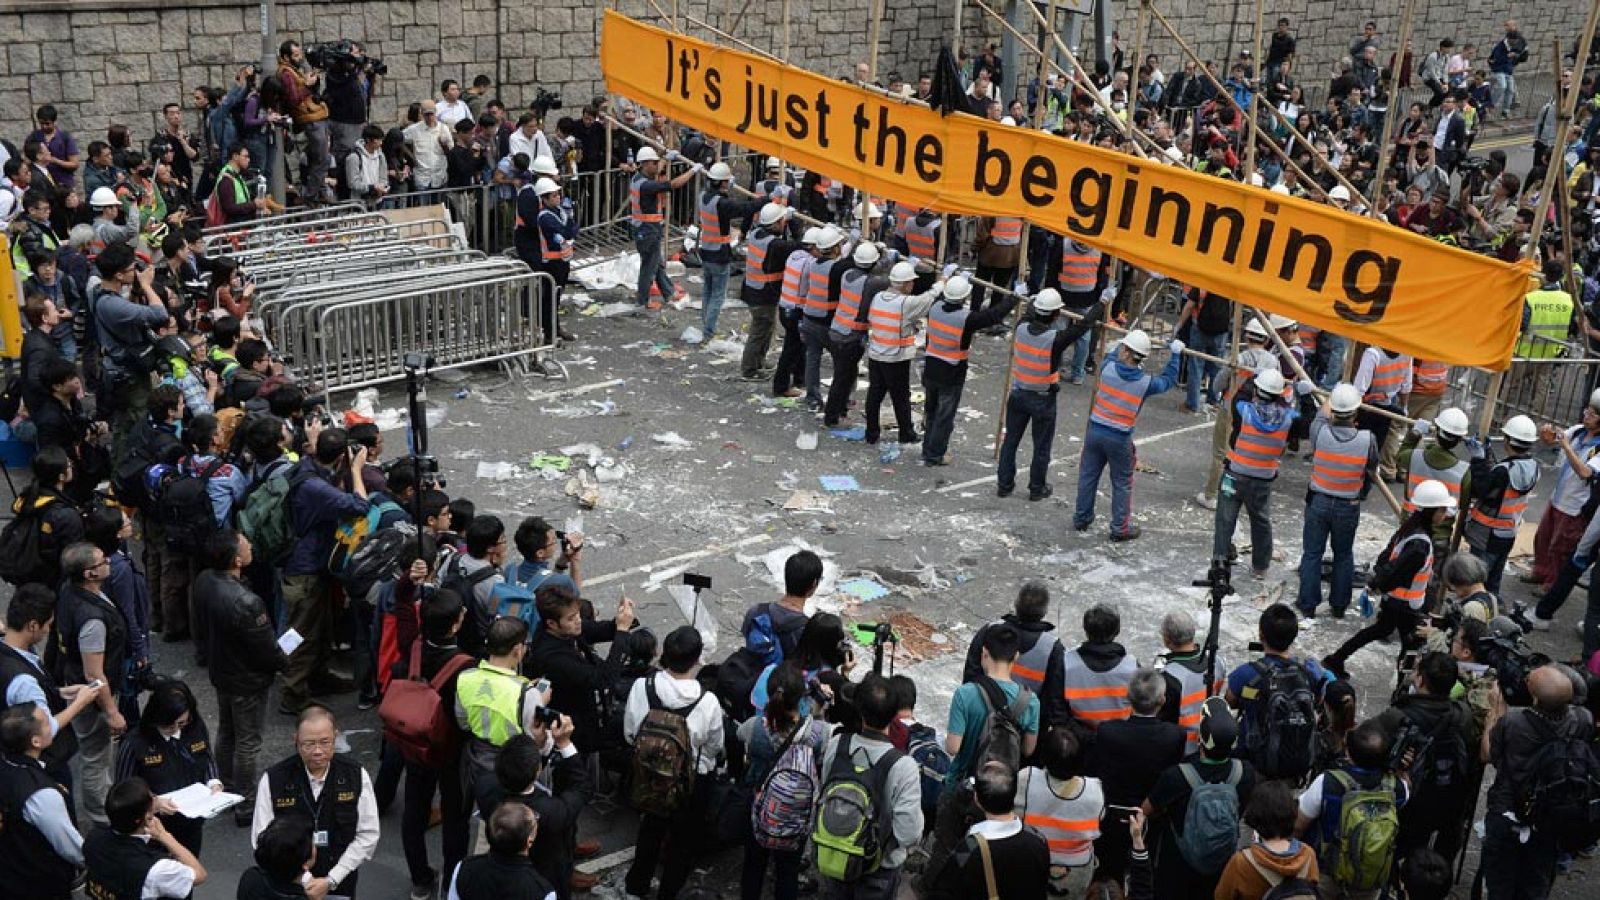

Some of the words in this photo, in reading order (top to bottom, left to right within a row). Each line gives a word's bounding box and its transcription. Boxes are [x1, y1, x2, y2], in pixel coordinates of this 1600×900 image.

[664, 38, 722, 111] It's
[735, 64, 831, 148] just
[852, 102, 944, 184] the
[973, 129, 1402, 324] beginning
[1533, 303, 1569, 313] PRESS
